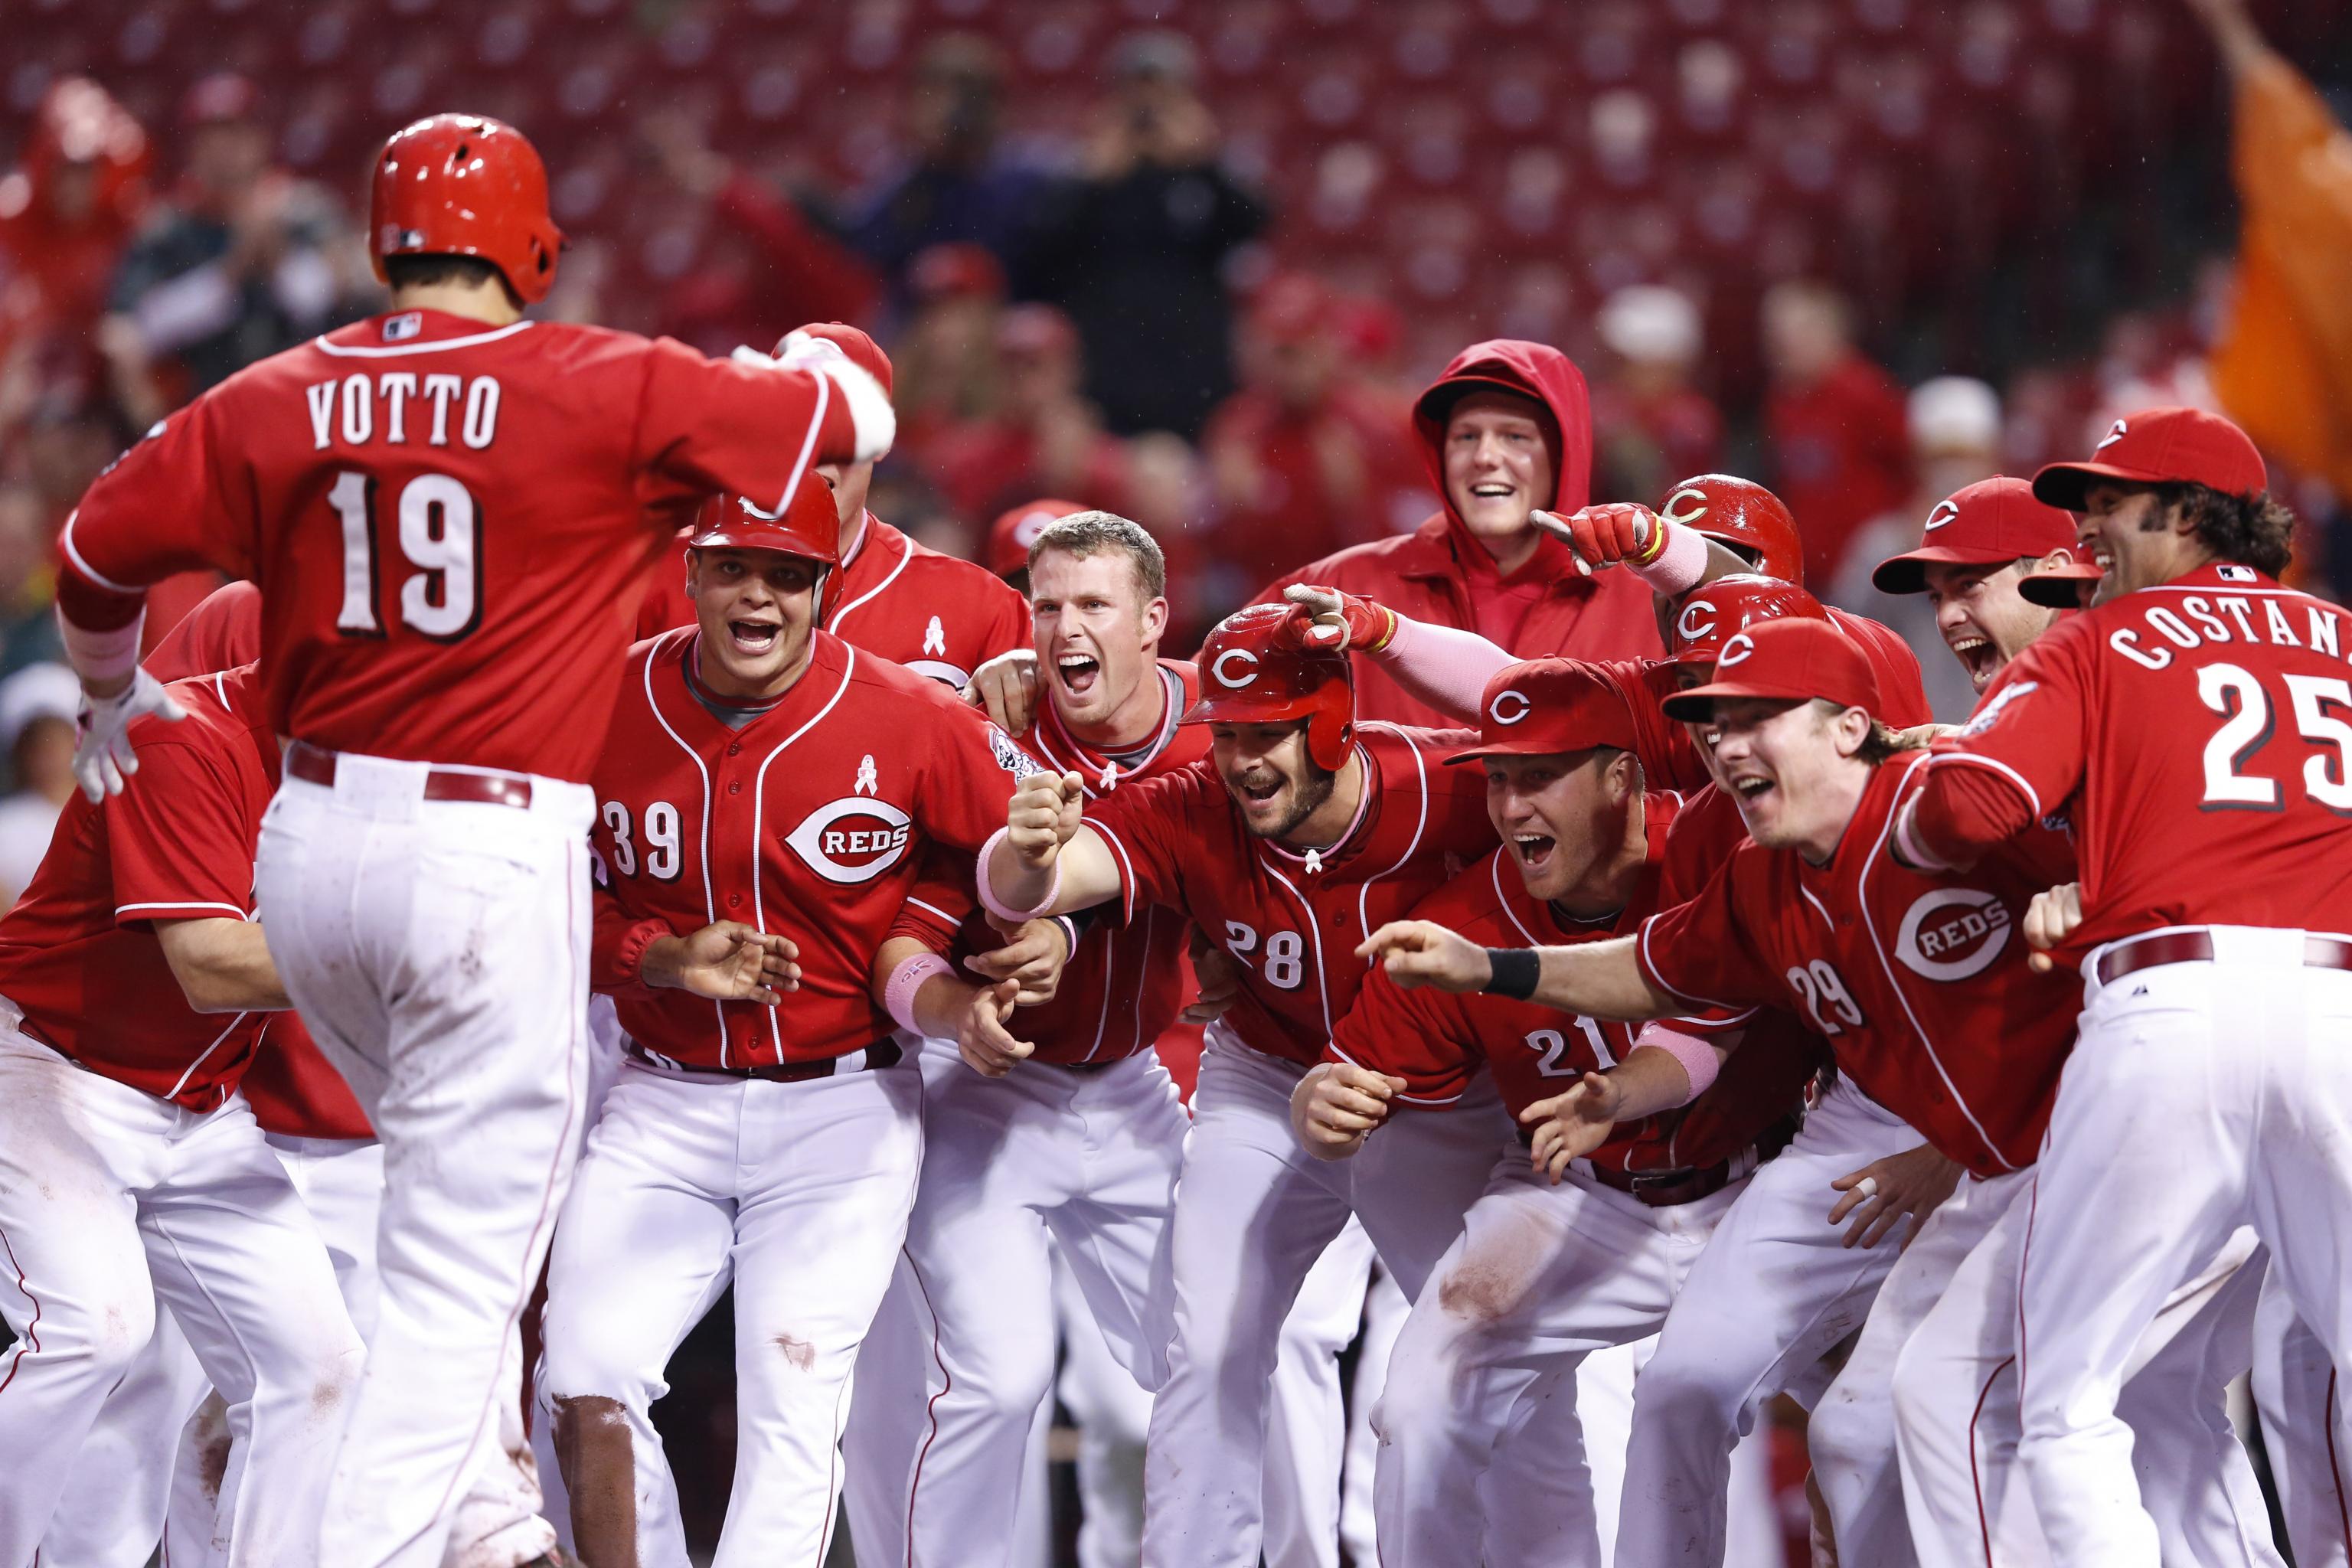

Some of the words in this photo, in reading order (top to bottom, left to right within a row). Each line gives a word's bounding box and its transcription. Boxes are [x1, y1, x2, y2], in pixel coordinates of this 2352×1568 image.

[306, 373, 500, 449] VOTTO
[1662, 489, 1707, 524] C
[1926, 500, 1958, 531] C
[328, 471, 479, 639] 19
[1677, 600, 1717, 640] C
[2109, 596, 2352, 671] COSTAN
[1211, 648, 1259, 688] C
[1718, 634, 1754, 666] C
[1489, 691, 1530, 724] C
[2196, 662, 2352, 810] 25
[602, 801, 682, 880] 39
[825, 825, 910, 854] REDS
[1225, 920, 1303, 989] 28
[1919, 900, 2011, 957] REDS
[1785, 959, 1864, 1034] 29
[1524, 1015, 1619, 1077] 21
